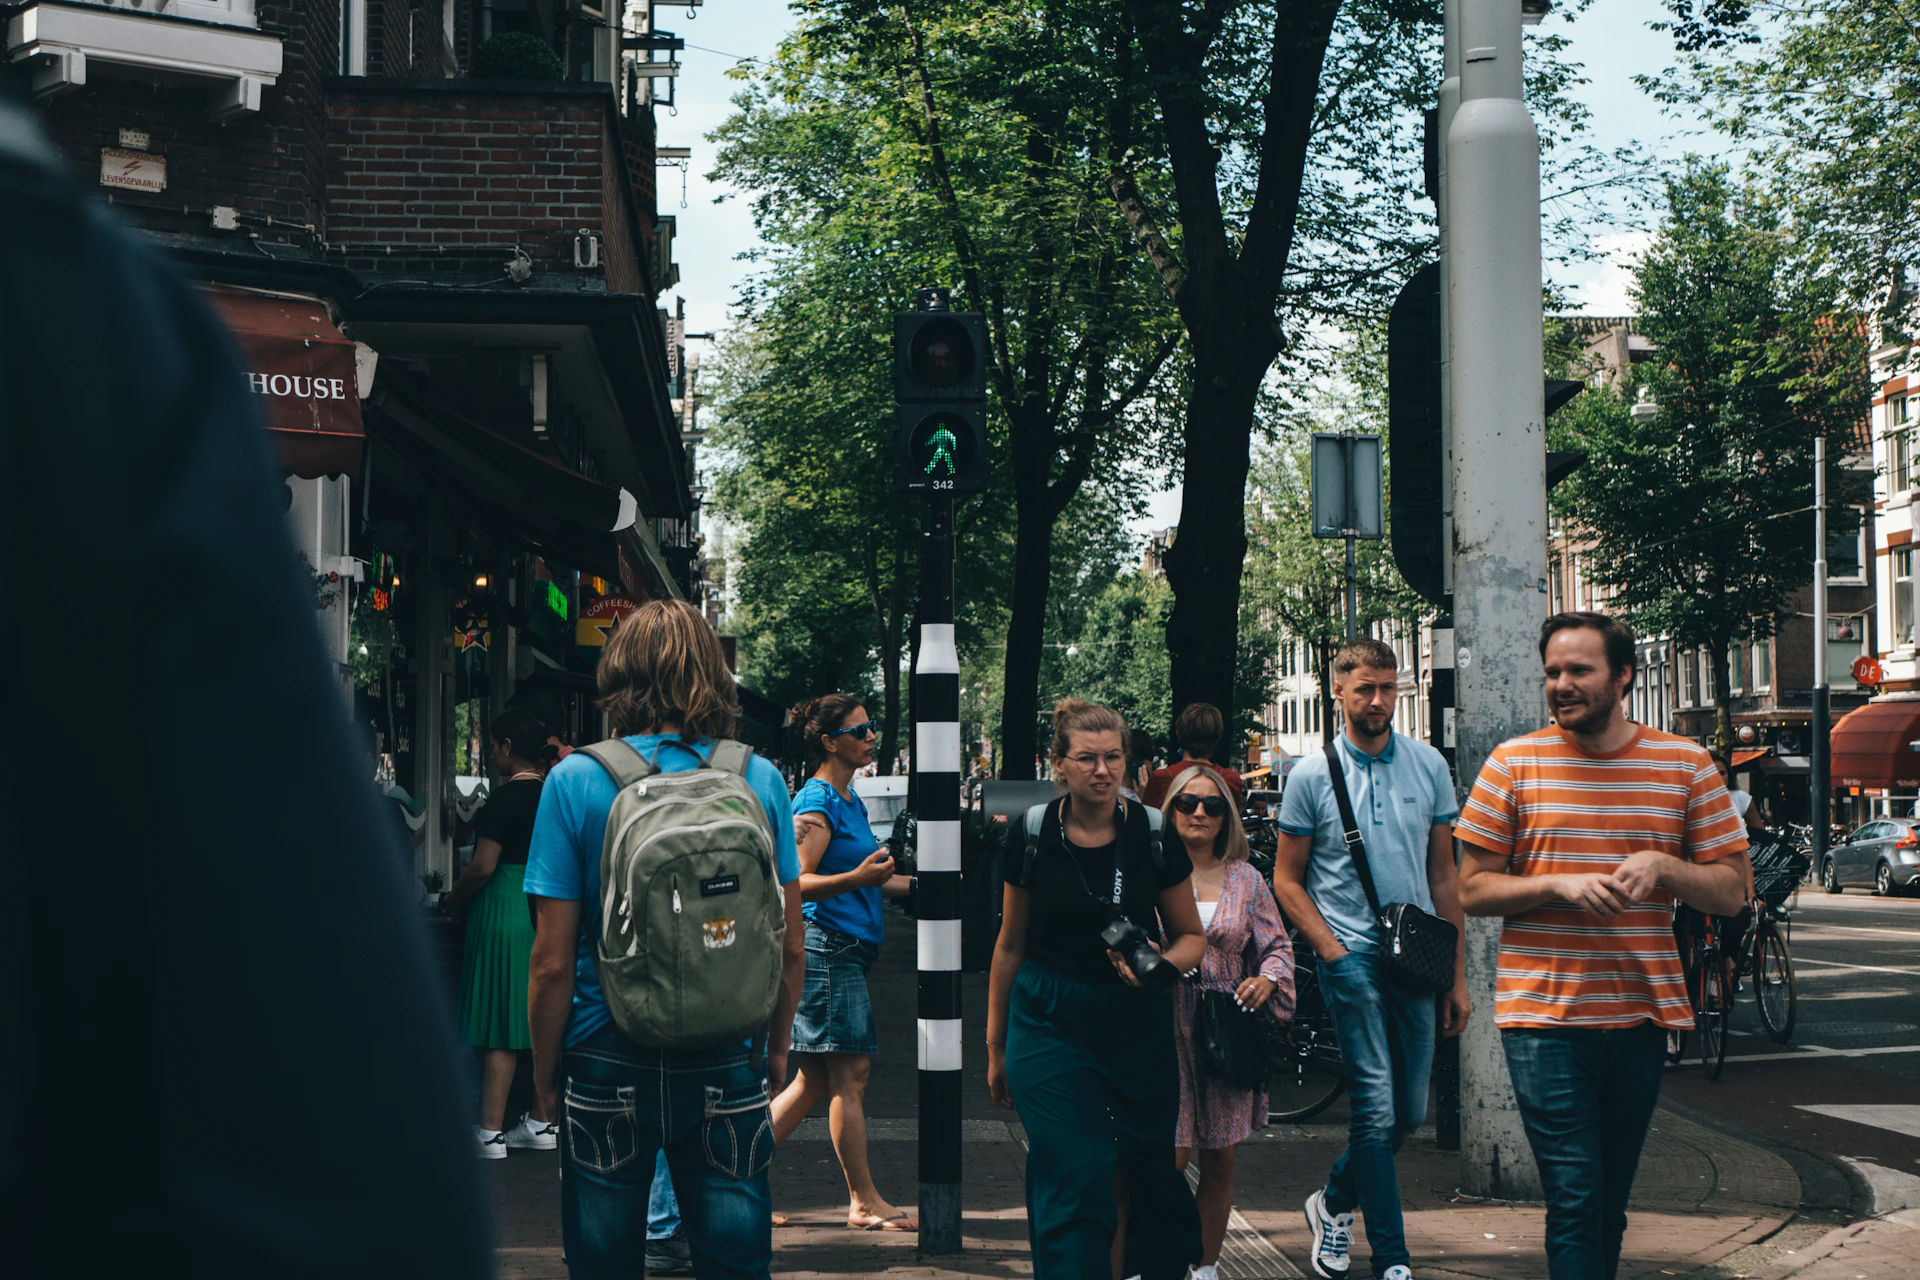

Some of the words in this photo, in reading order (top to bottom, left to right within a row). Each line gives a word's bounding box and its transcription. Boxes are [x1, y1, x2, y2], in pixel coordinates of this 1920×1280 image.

[104, 149, 166, 164] HOOGSPANNING
[102, 174, 164, 188] LEVENSGEVAARLIJK
[241, 372, 346, 400] HOUSE
[933, 480, 954, 490] 342
[587, 598, 638, 617] COFFEESH
[1112, 867, 1123, 905] SONY
